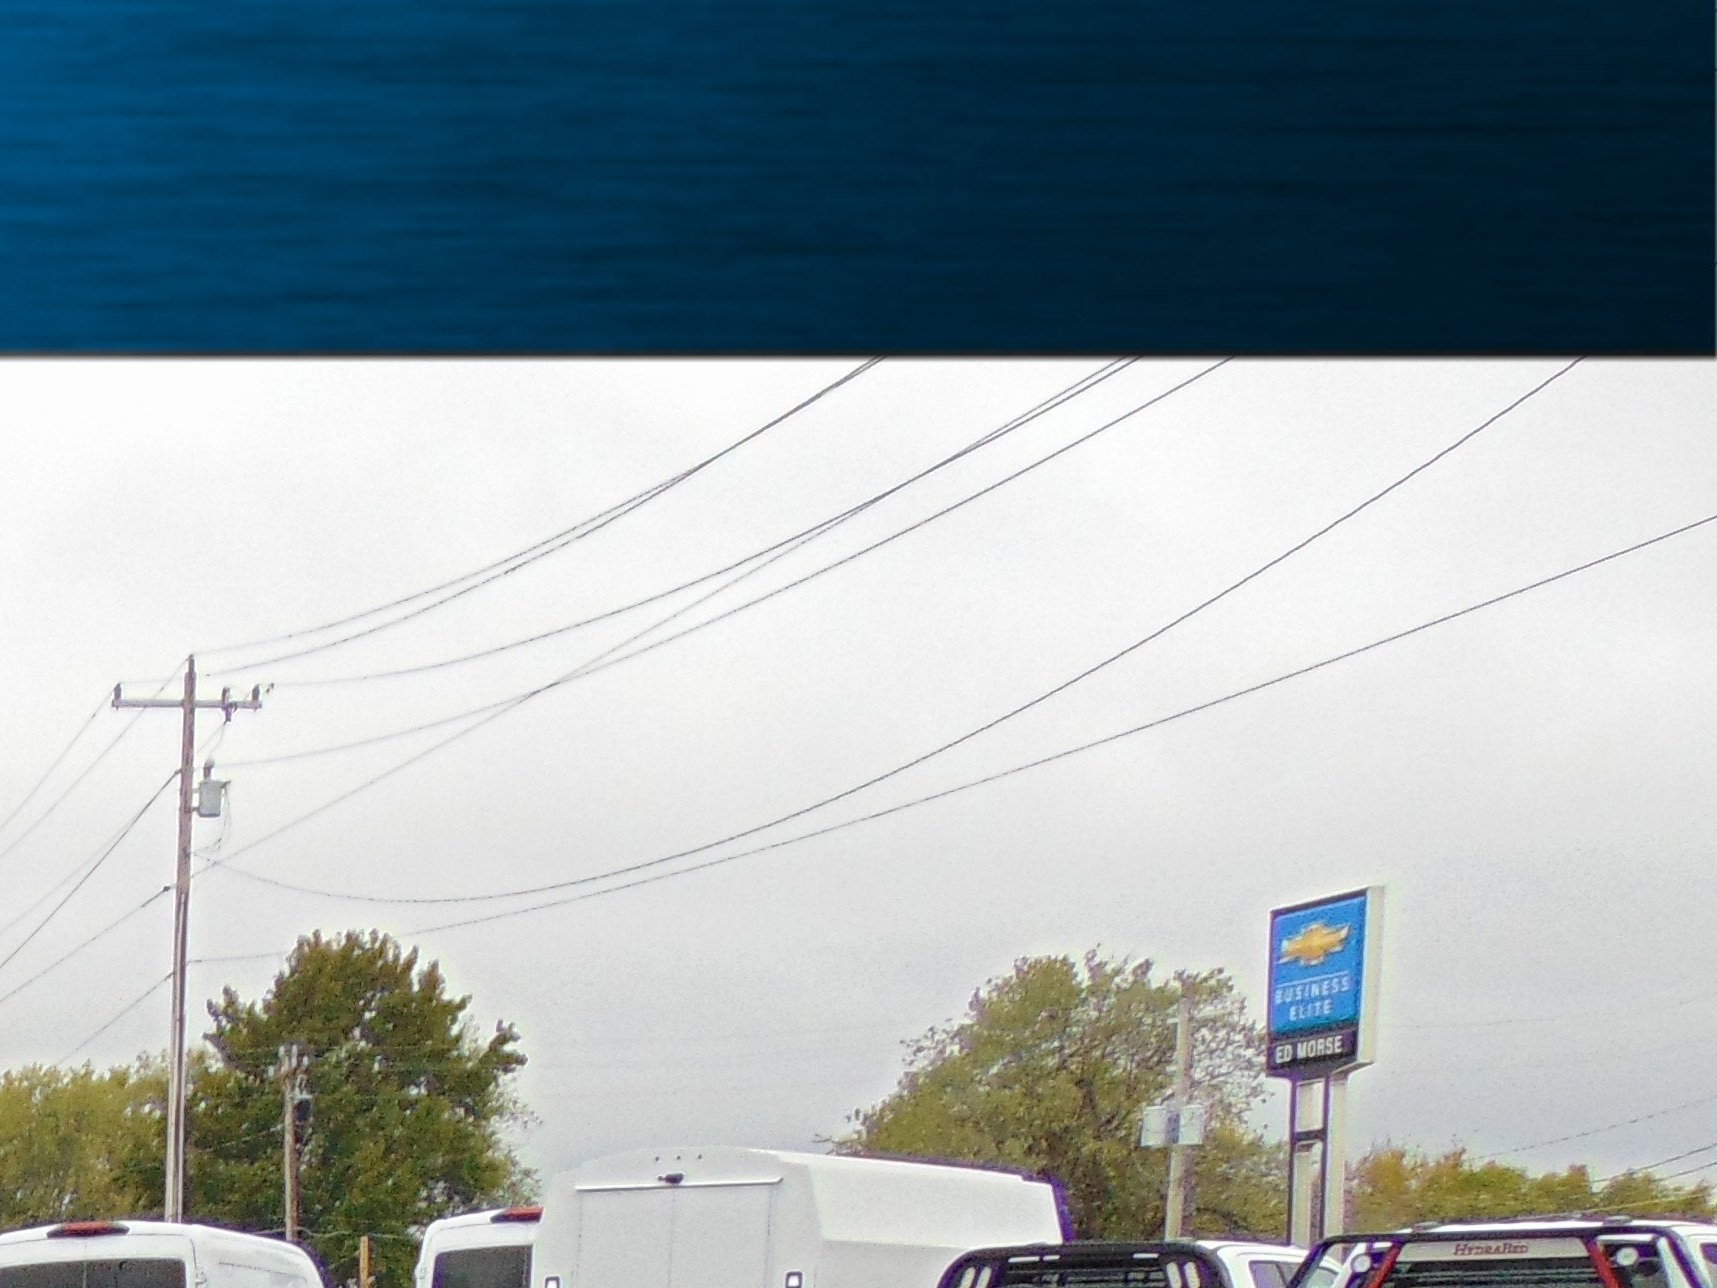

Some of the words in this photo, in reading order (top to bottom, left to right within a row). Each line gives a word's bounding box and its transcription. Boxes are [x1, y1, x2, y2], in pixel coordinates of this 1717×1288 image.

[1275, 976, 1349, 1005] BUSINESS
[1289, 999, 1332, 1021] ELITE
[1275, 1044, 1292, 1064] ED
[1296, 1035, 1343, 1060] MORSE
